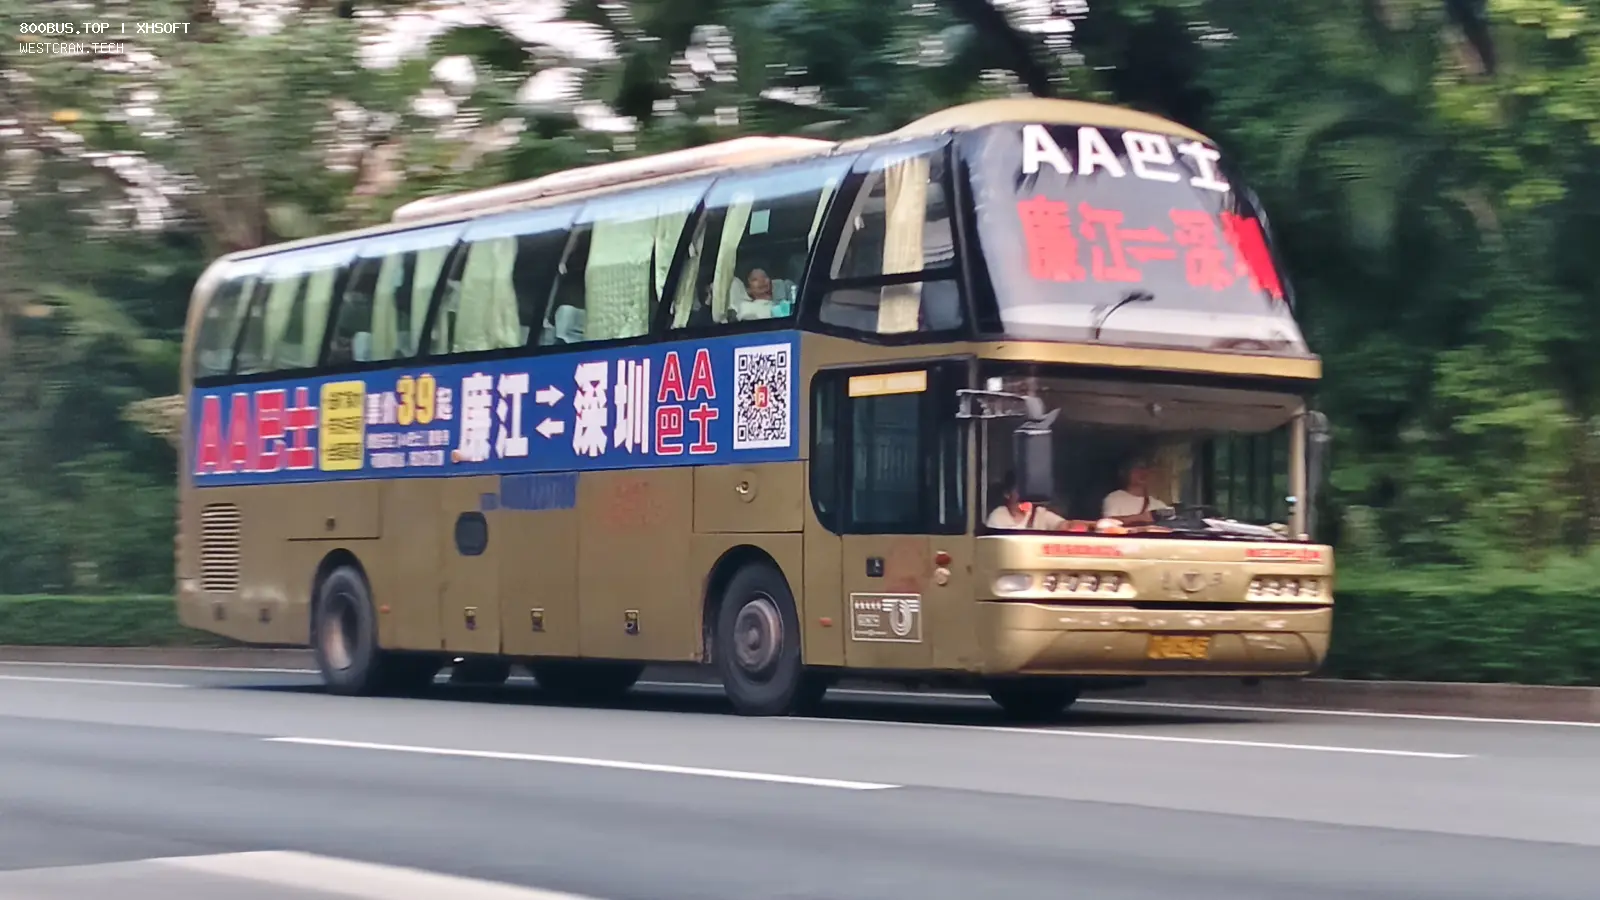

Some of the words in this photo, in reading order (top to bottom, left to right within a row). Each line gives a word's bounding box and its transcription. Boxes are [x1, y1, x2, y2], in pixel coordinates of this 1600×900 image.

[1022, 124, 1231, 193] AA巴士
[194, 386, 319, 475] AA巴士
[459, 372, 530, 461] 廉江
[572, 358, 651, 457] 深圳
